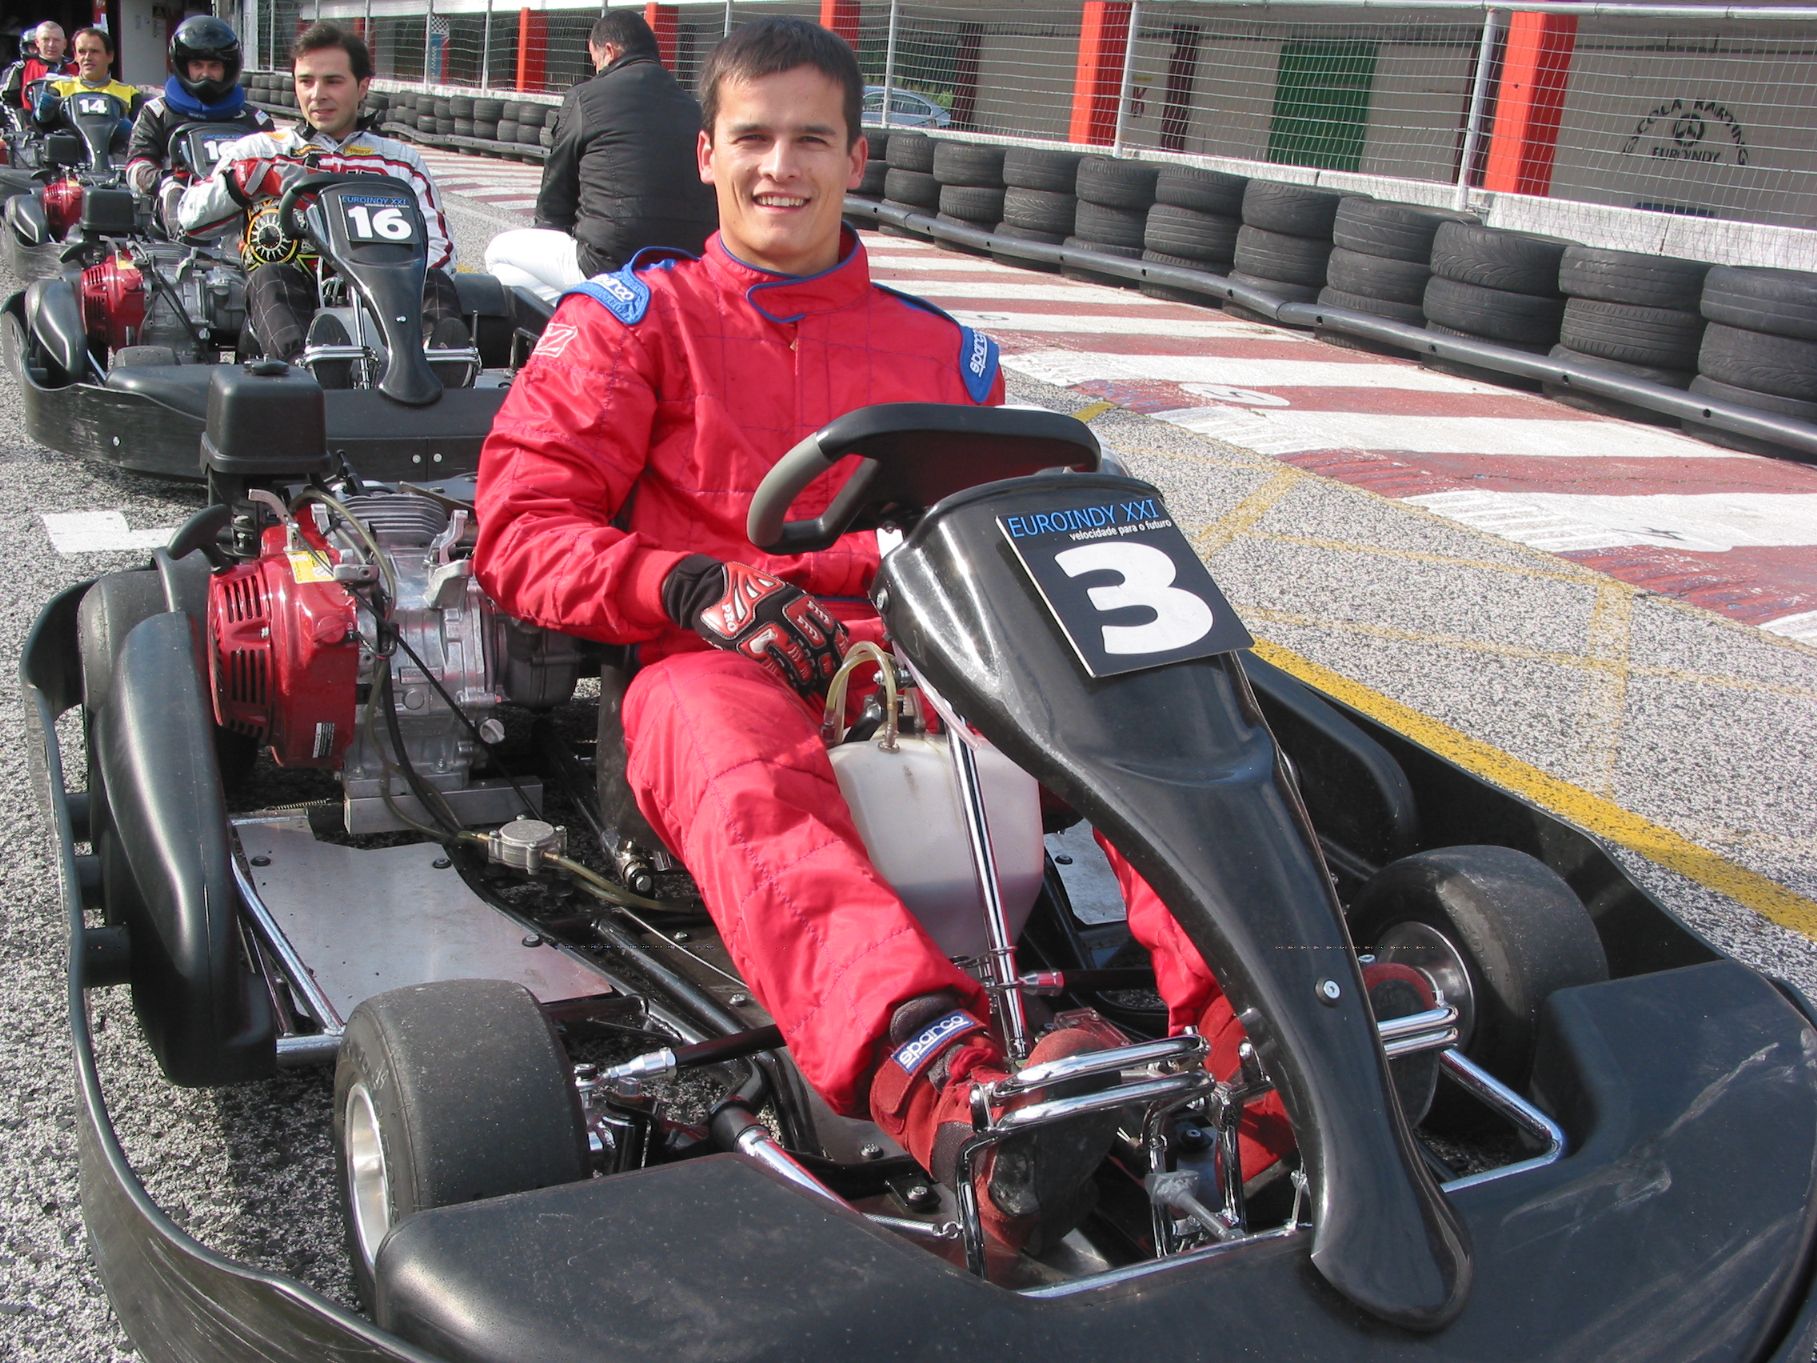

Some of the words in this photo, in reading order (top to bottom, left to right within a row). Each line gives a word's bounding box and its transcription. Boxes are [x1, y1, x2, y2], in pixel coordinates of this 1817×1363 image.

[79, 99, 107, 113] 14
[1652, 147, 1721, 163] EUROINDY
[347, 206, 412, 240] 16
[969, 328, 987, 377] sparc
[1008, 505, 1116, 537] EUROINDY
[1120, 500, 1159, 522] XXI
[1069, 527, 1117, 541] velocidade
[1118, 525, 1138, 536] para
[1146, 519, 1172, 530] futuro
[1054, 541, 1213, 654] 3
[722, 603, 738, 632] PRO
[899, 1015, 969, 1068] sparco
